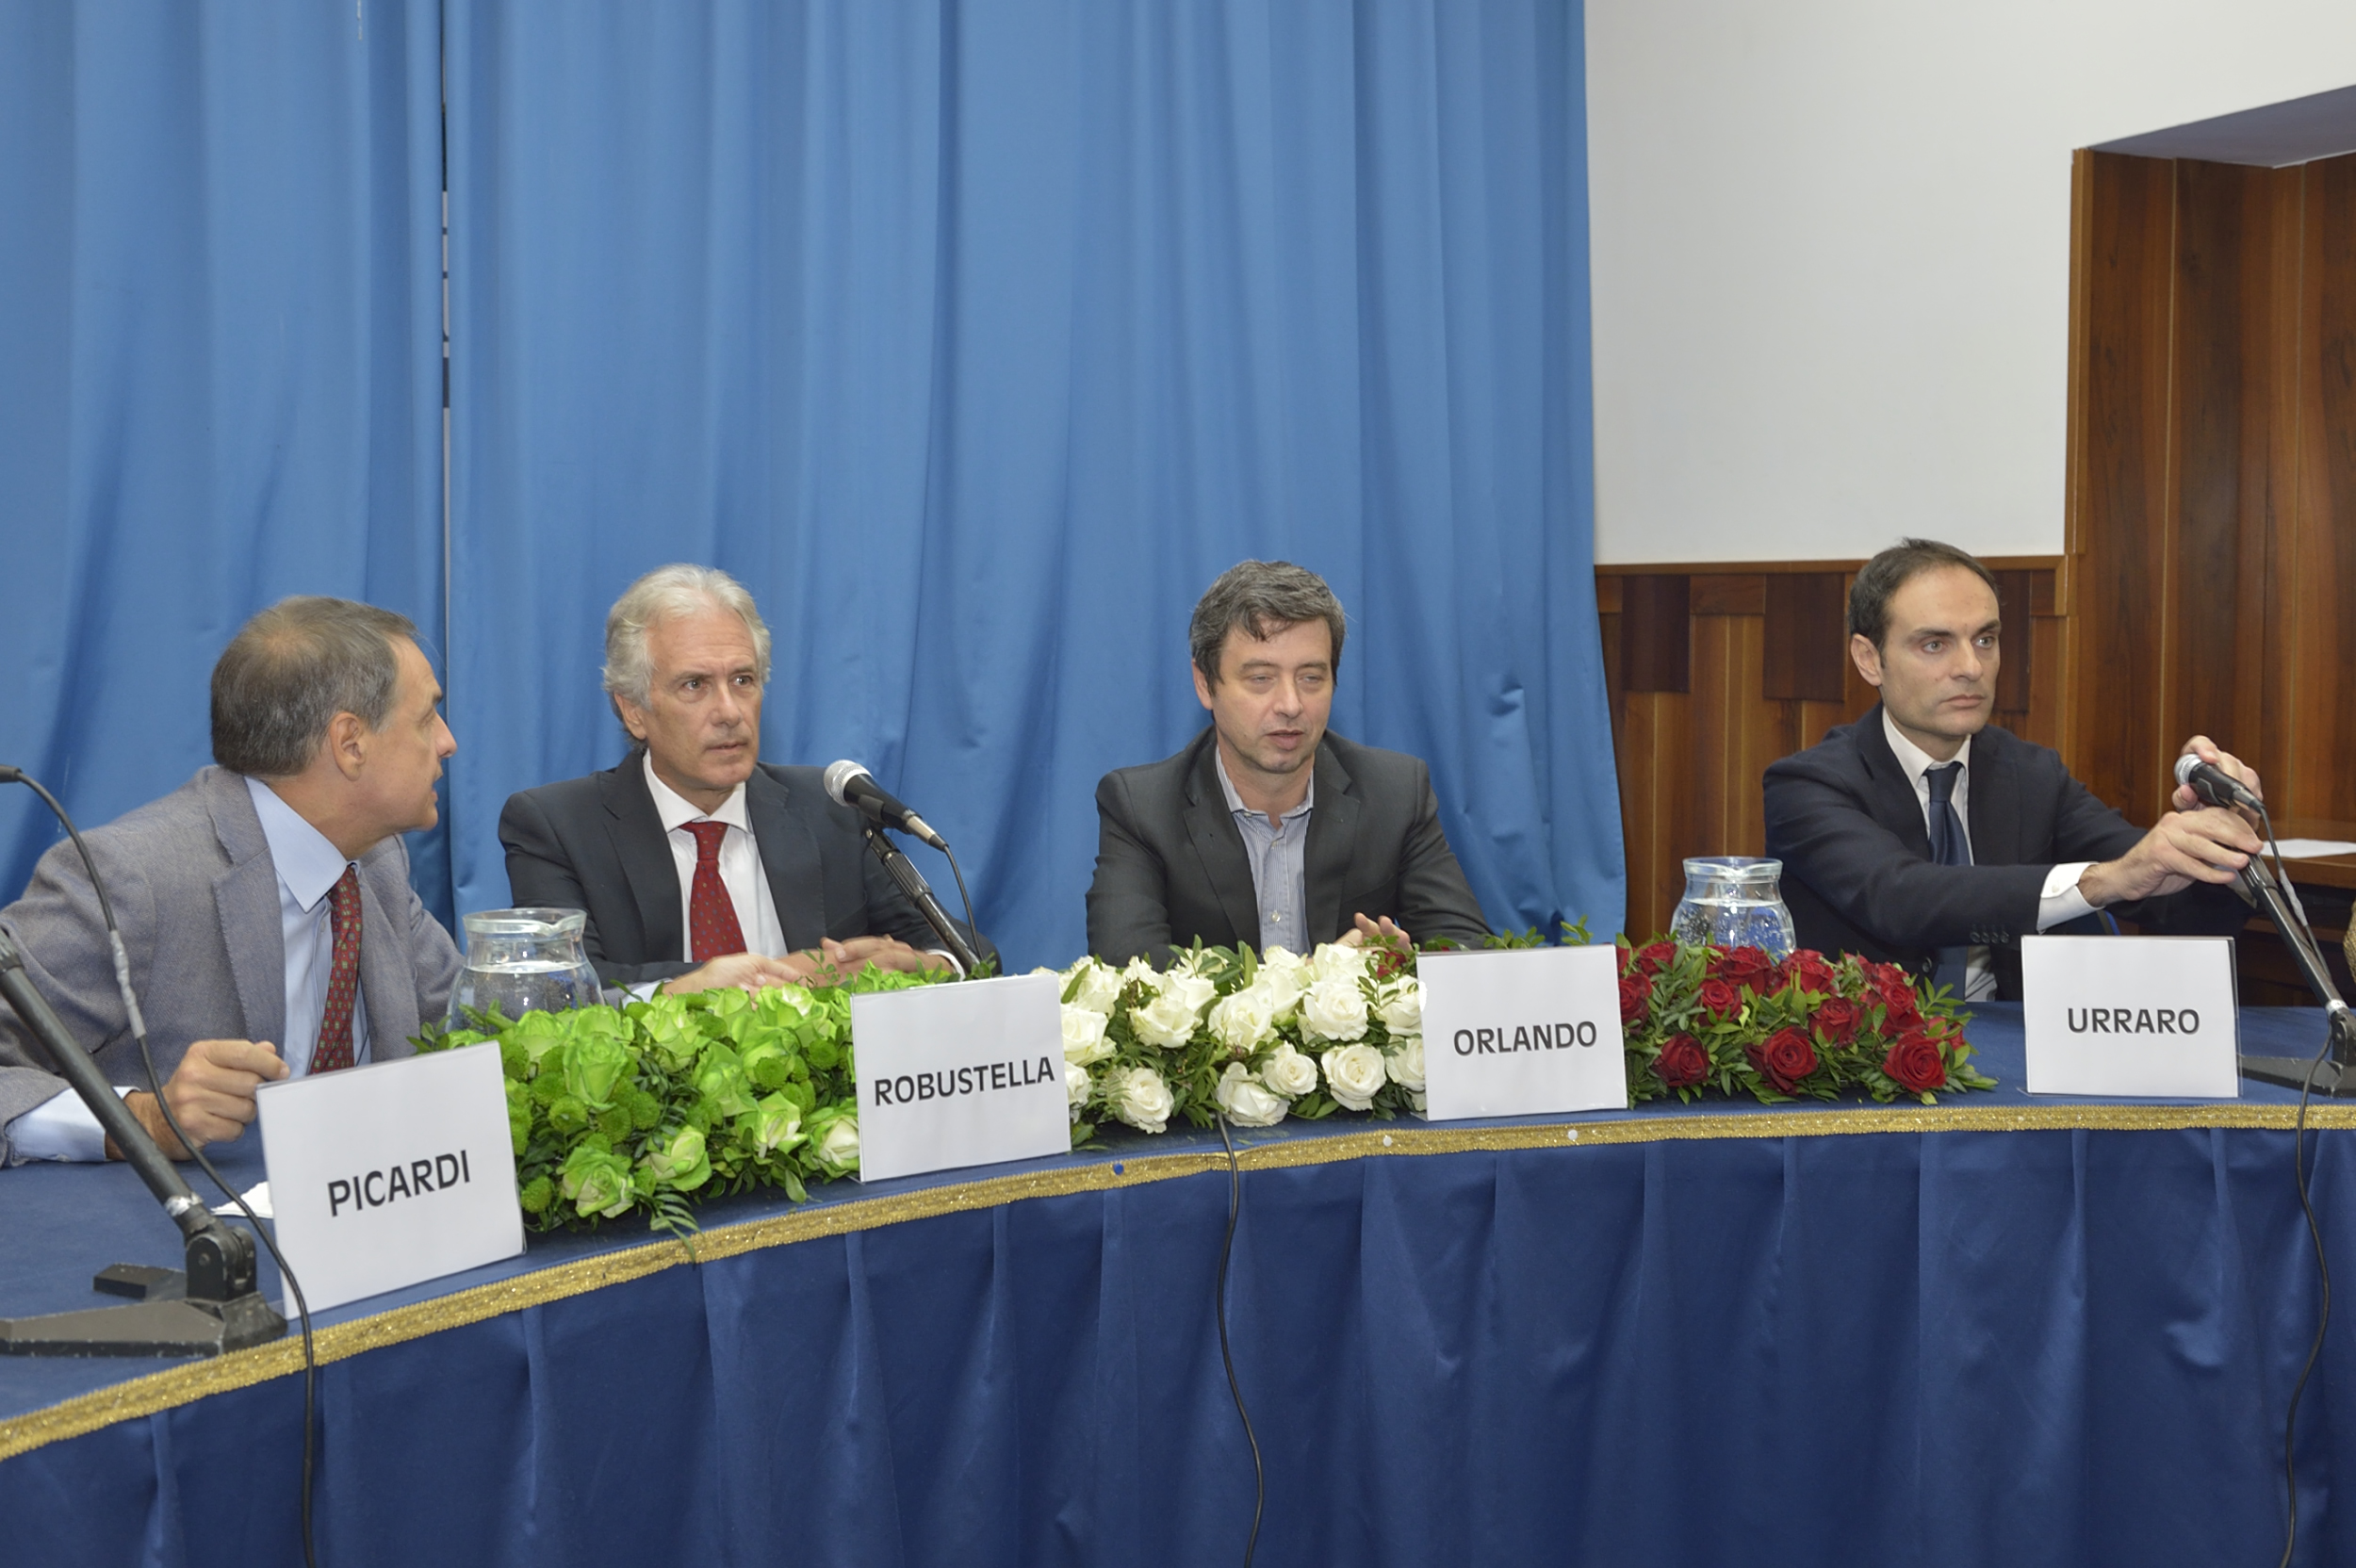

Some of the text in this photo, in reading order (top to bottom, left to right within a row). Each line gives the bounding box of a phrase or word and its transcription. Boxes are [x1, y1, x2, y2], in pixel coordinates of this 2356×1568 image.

[1453, 1021, 1597, 1055] ORLANDO
[2068, 1008, 2200, 1034] URRARO
[875, 1056, 1055, 1106] ROBUSTELLA
[328, 1150, 470, 1217] PICARDI
